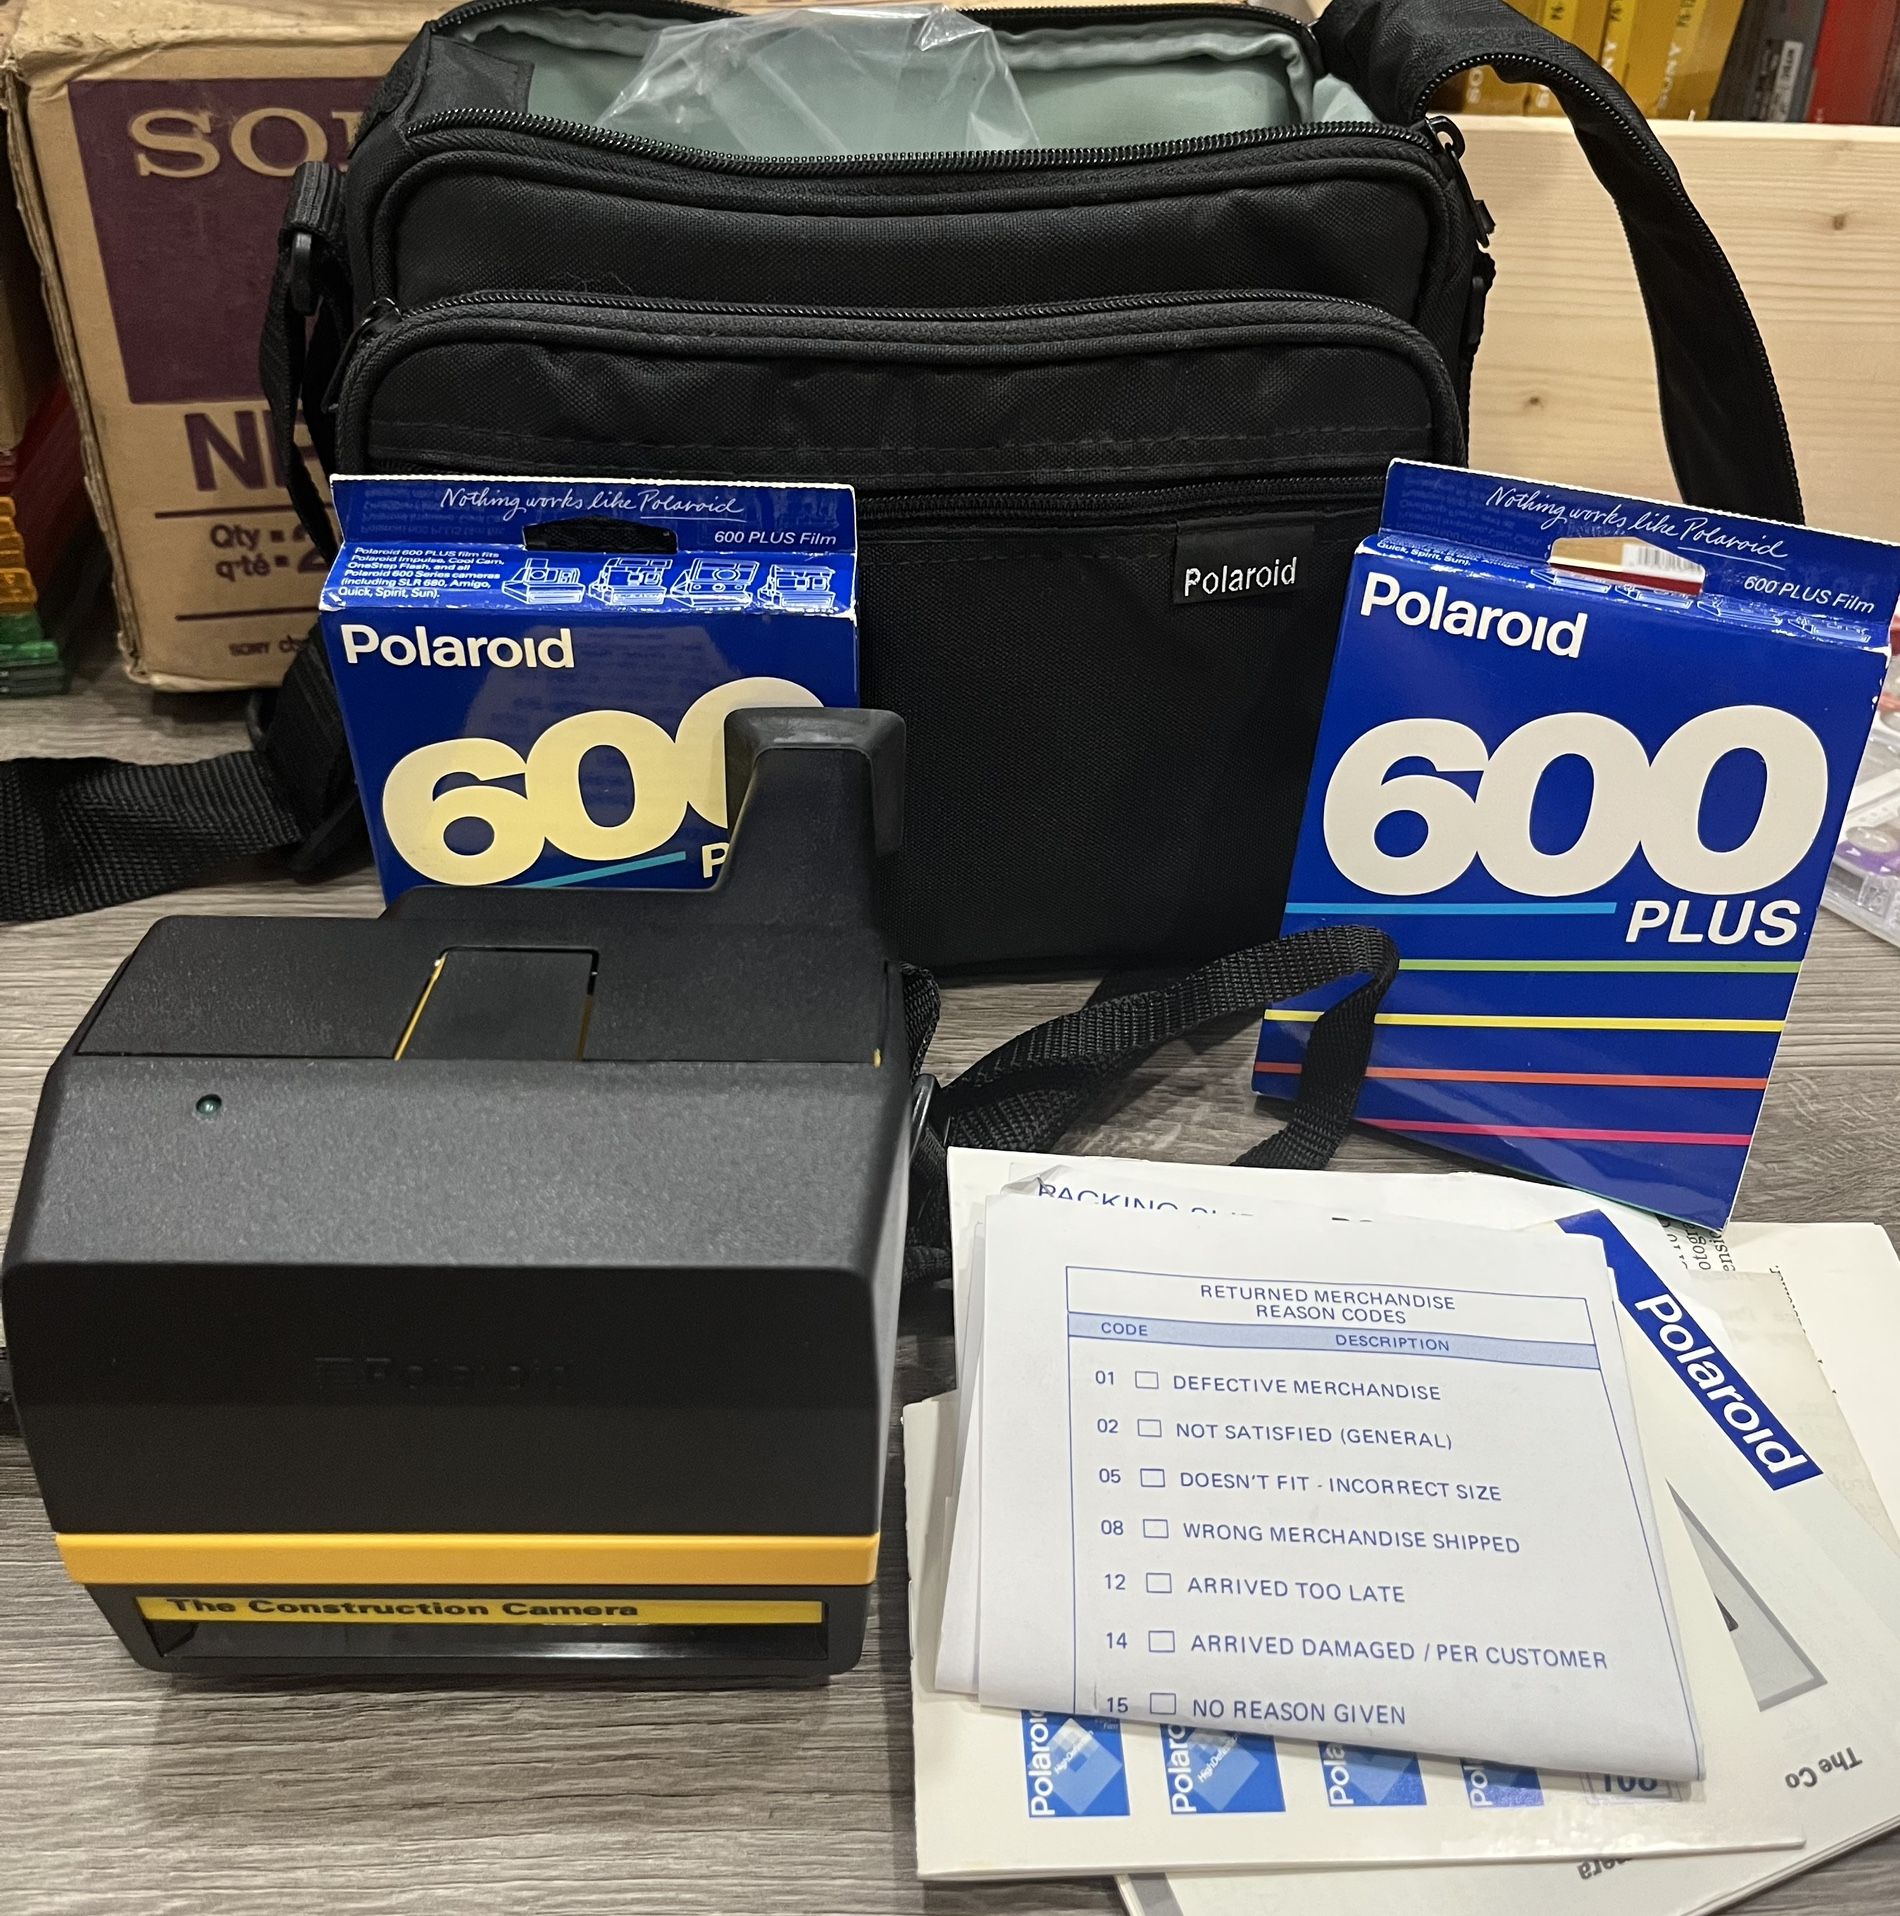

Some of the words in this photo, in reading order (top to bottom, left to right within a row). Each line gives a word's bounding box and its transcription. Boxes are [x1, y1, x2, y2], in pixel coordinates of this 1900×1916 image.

[440, 487, 527, 521] Nothing
[525, 488, 583, 509] works
[587, 490, 636, 511] like
[639, 489, 745, 514] Polaroid
[1485, 486, 1566, 529] Nothing
[1569, 503, 1626, 529] works
[1629, 513, 1679, 537] like
[1680, 517, 1788, 558] Polaroid
[354, 547, 400, 556] Polaroid
[426, 549, 457, 557] PLUS
[457, 550, 480, 558] film
[714, 531, 745, 543] 600
[748, 531, 796, 544] PLUS
[800, 532, 837, 545] Film
[1376, 541, 1408, 553] Quick,
[1410, 548, 1441, 561] Spirit,
[344, 569, 390, 578] Polaroid
[392, 570, 413, 578] 600
[415, 571, 450, 579] Series
[451, 572, 500, 580] cameras
[347, 562, 397, 571] OneStep
[399, 563, 431, 571] Flash,
[456, 563, 470, 571] all
[351, 554, 396, 563] Polaroid
[398, 556, 446, 565] Impulse,
[475, 557, 505, 566] Cam,
[341, 577, 396, 587] (including
[398, 578, 422, 586] SLR
[424, 579, 447, 588] 680,
[451, 579, 492, 589] Amigo,
[1184, 556, 1297, 597] Polaroid
[338, 587, 373, 597] Quick,
[375, 587, 408, 599] Spirit,
[411, 588, 440, 599] Sun).
[1744, 576, 1778, 594] 600
[1778, 582, 1832, 605] PLUS
[1832, 593, 1875, 613] Film
[1360, 571, 1588, 660] Polaroid
[340, 623, 575, 668] Polaroid
[1322, 704, 1829, 897] 600
[1625, 899, 1801, 946] PLUS
[1200, 1284, 1308, 1302] RETURNED
[1314, 1290, 1456, 1310] MERCHANDISE
[1256, 1304, 1335, 1321] REASON
[1342, 1308, 1406, 1325] CODES
[1100, 1321, 1148, 1337] CODE
[1336, 1334, 1450, 1352] DESCRIPTION
[1095, 1370, 1115, 1387] 01
[1172, 1374, 1288, 1394] DEFECTIVE
[1293, 1379, 1442, 1401] MERCHANDISE
[1634, 1293, 1809, 1474] Polaroid
[1096, 1418, 1119, 1434] 02
[1176, 1422, 1218, 1439] NOT
[1224, 1424, 1333, 1444] SATISFIED
[1339, 1428, 1453, 1451] (GENERAL)
[1099, 1468, 1122, 1485] 05
[1179, 1471, 1270, 1490] DOESN'T
[1276, 1475, 1309, 1492] FIT
[1329, 1477, 1450, 1499] INCORRECT
[1456, 1483, 1502, 1502] SIZE
[1100, 1519, 1124, 1536] 08
[1183, 1522, 1264, 1543] WRONG
[1269, 1526, 1427, 1549] MERCHANDISE
[1433, 1533, 1521, 1555] SHIPPED
[1103, 1573, 1127, 1591] 12
[1187, 1576, 1289, 1598] ARRIVED
[1295, 1581, 1343, 1601] TOO
[1348, 1583, 1406, 1604] LATE
[165, 1598, 237, 1613] The
[247, 1599, 489, 1616] Construction
[501, 1602, 640, 1617] Camera
[1106, 1632, 1129, 1650] 14
[1191, 1634, 1295, 1657] ARRIVED
[1302, 1638, 1415, 1662] DAMAGED
[1424, 1642, 1432, 1663] /
[1437, 1644, 1479, 1665] PER
[1486, 1646, 1609, 1670] CUSTOMER
[1106, 1697, 1129, 1713] 15
[1192, 1699, 1224, 1718] NO
[1233, 1700, 1325, 1721] REASON
[1334, 1703, 1407, 1726] GIVEN
[1818, 1746, 1863, 1773] The
